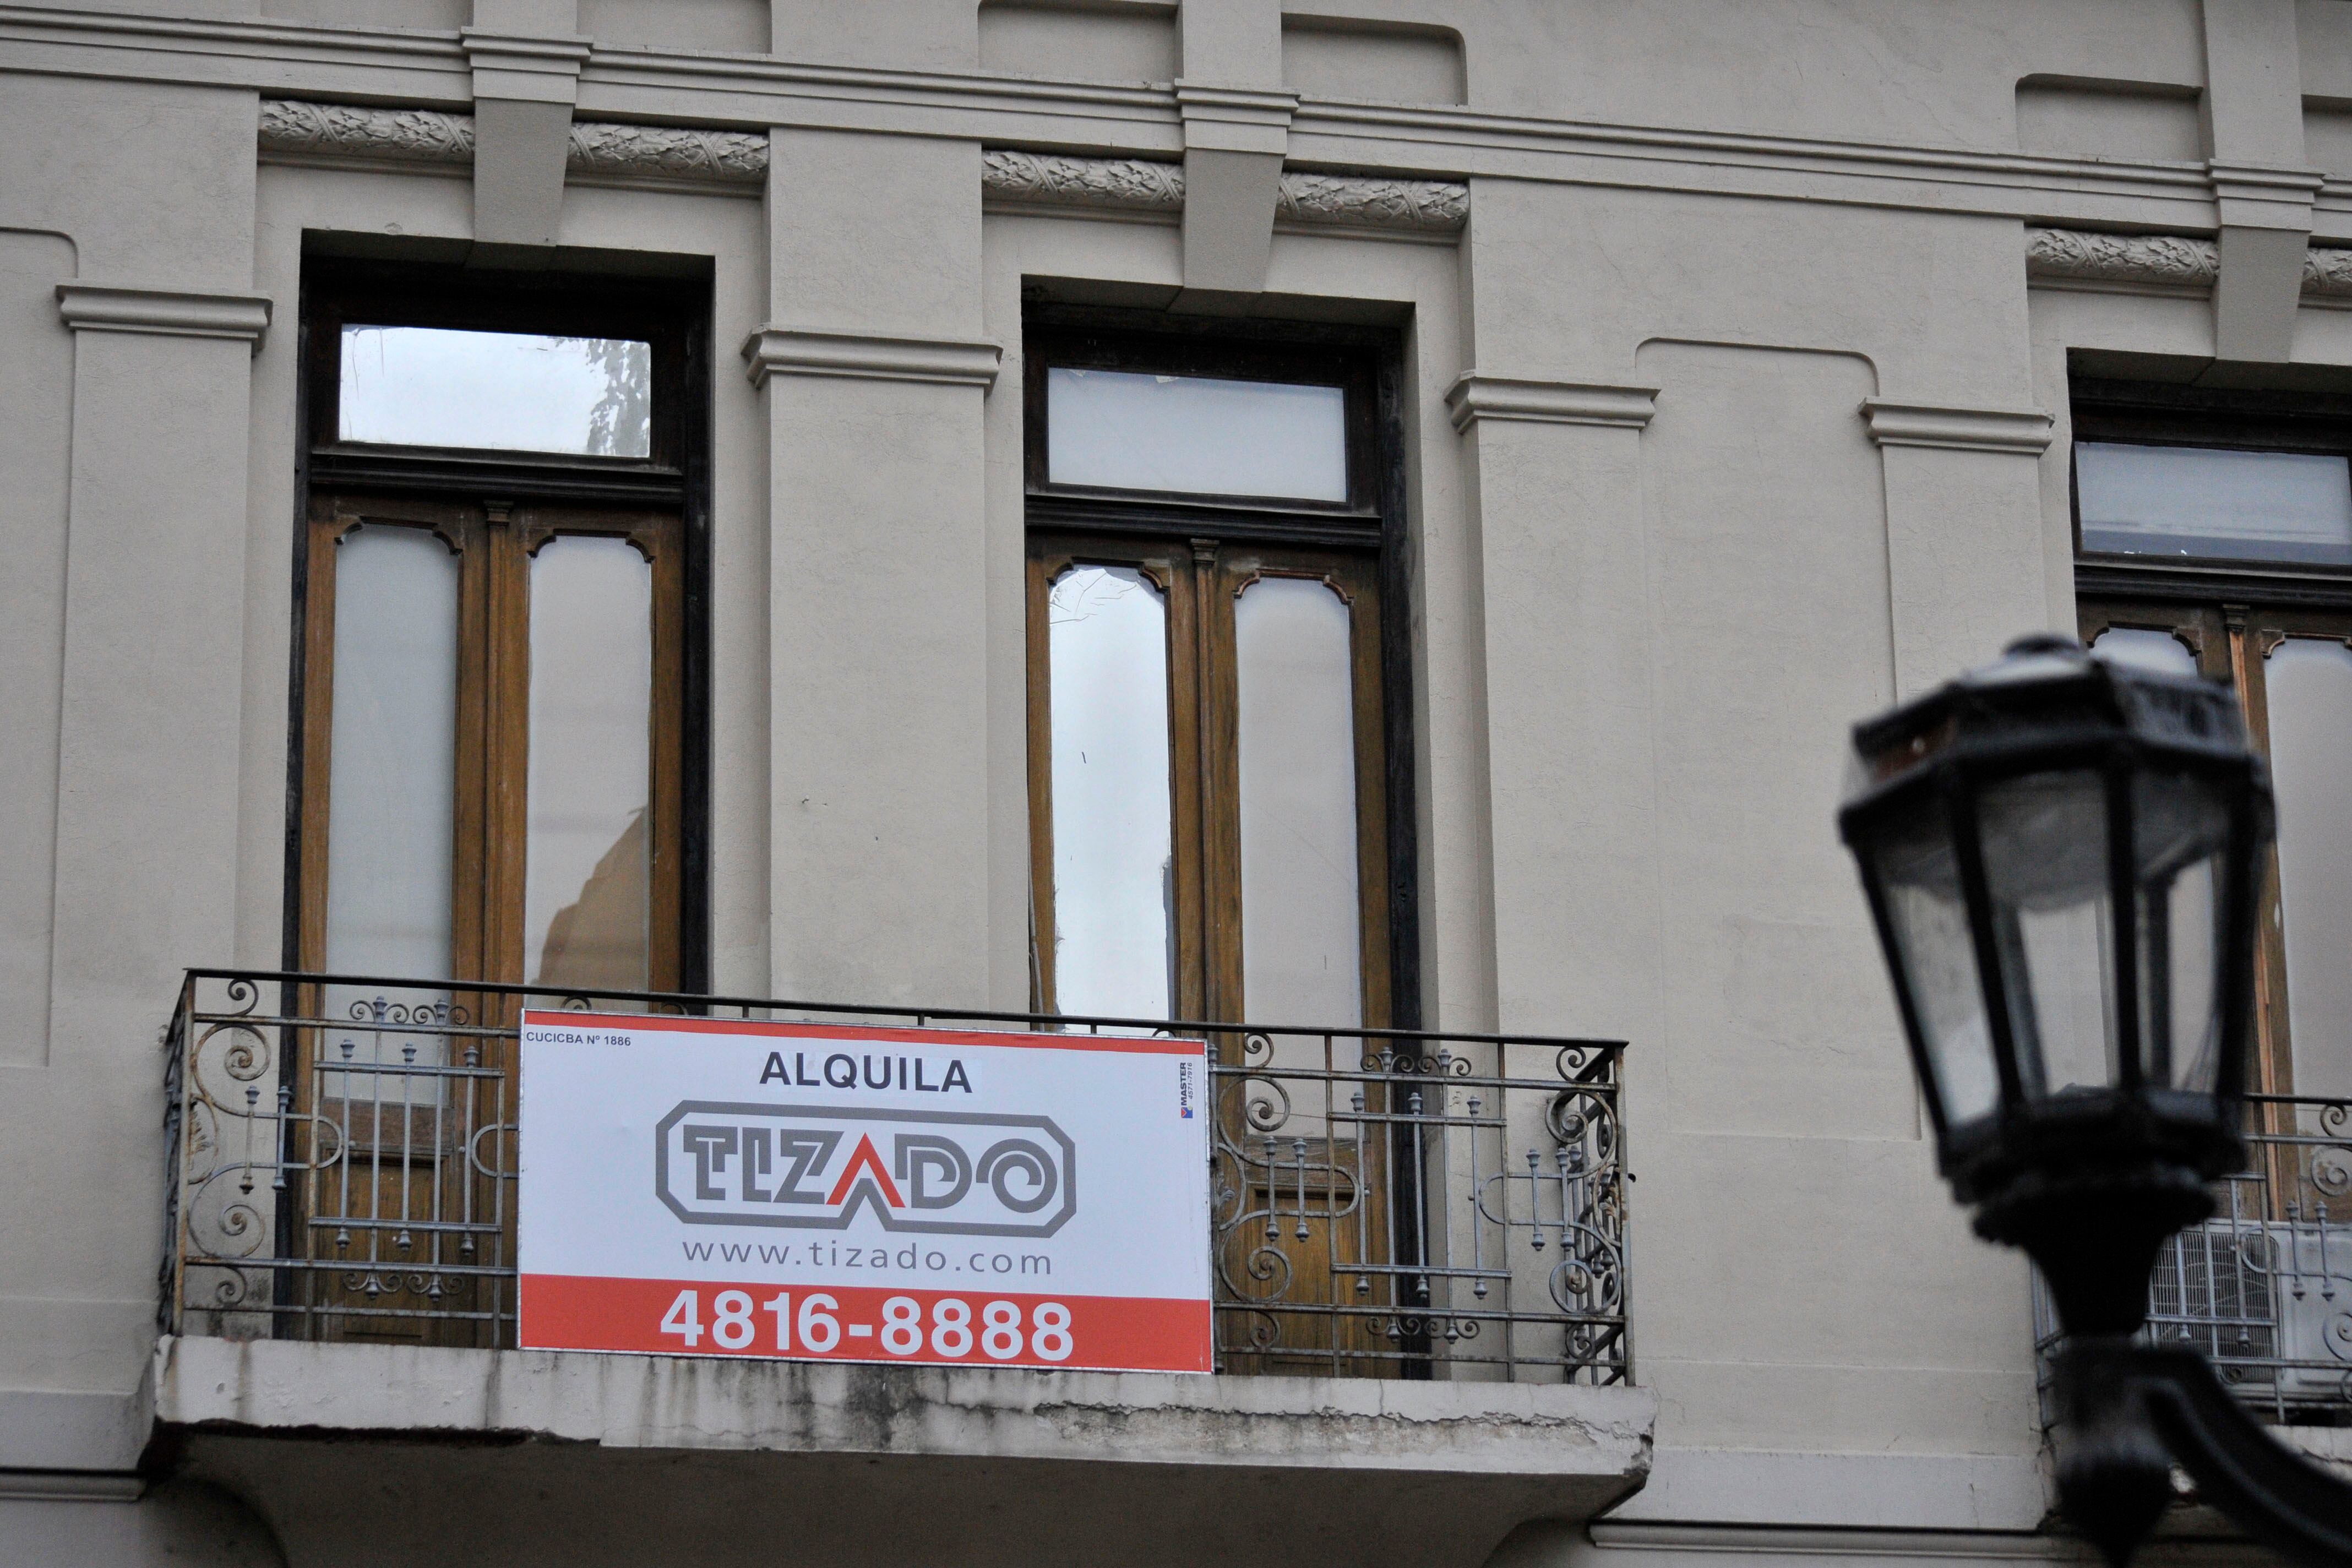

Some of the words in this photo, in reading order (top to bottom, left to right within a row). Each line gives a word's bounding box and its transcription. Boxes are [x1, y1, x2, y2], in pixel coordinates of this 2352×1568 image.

[526, 1032, 584, 1044] CUCICBA
[605, 1036, 631, 1046] 1886
[760, 1052, 973, 1093] ALQUILA
[683, 1124, 1058, 1213] TIZADO
[682, 1240, 1052, 1275] www.tizado.com
[661, 1290, 1074, 1361] 4816-8888
